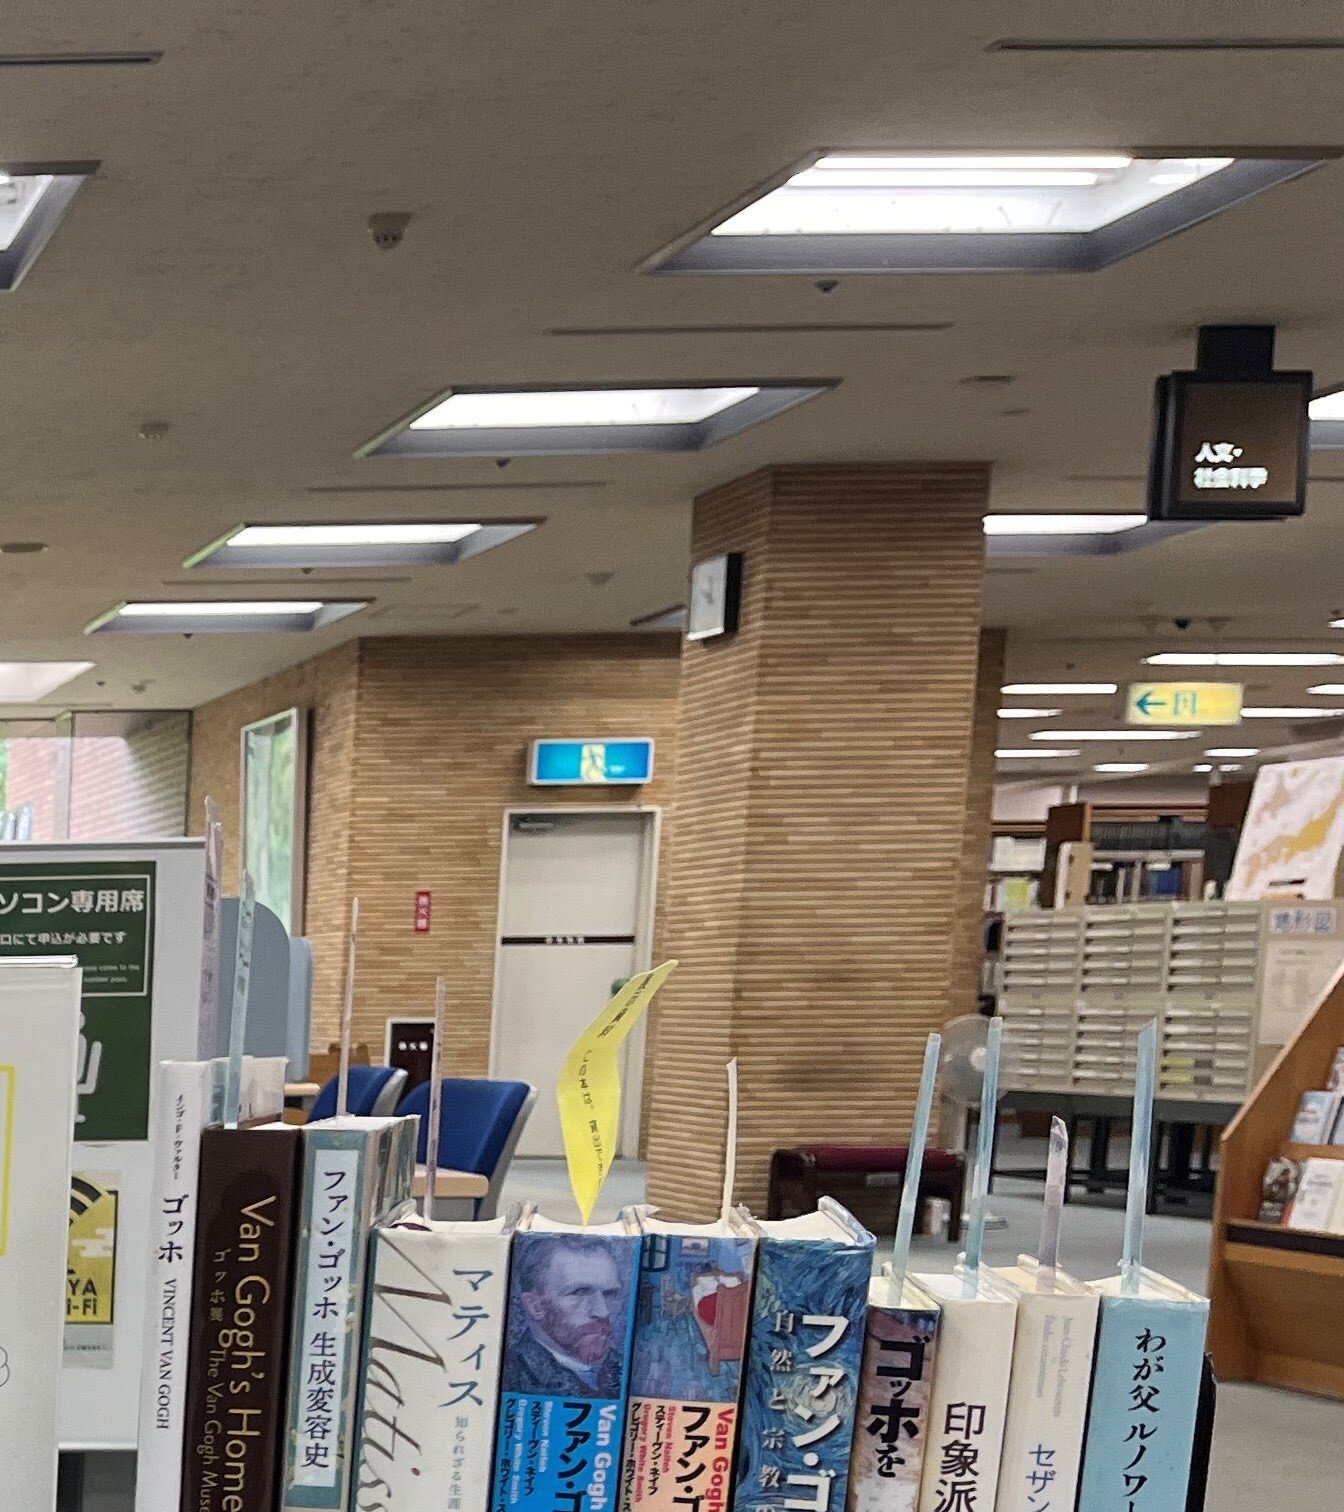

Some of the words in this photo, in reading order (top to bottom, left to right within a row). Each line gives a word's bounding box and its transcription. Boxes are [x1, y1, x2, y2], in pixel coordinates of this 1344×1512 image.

[158, 1193, 190, 1264] ゴッホ
[239, 1195, 277, 1263] Van
[311, 1170, 349, 1320] ファン・ゴッホ
[159, 1278, 178, 1348] VINCENT
[218, 1274, 272, 1395] Gogh's
[437, 1268, 494, 1409] マティス
[158, 1350, 174, 1382] VAN
[208, 1350, 227, 1379] The
[155, 1384, 172, 1430] GOGH
[207, 1381, 224, 1415] Van
[301, 1331, 338, 1469] 生成変容史
[596, 1404, 618, 1447] Van
[713, 1406, 736, 1447] Van
[197, 1418, 223, 1468] Gogh
